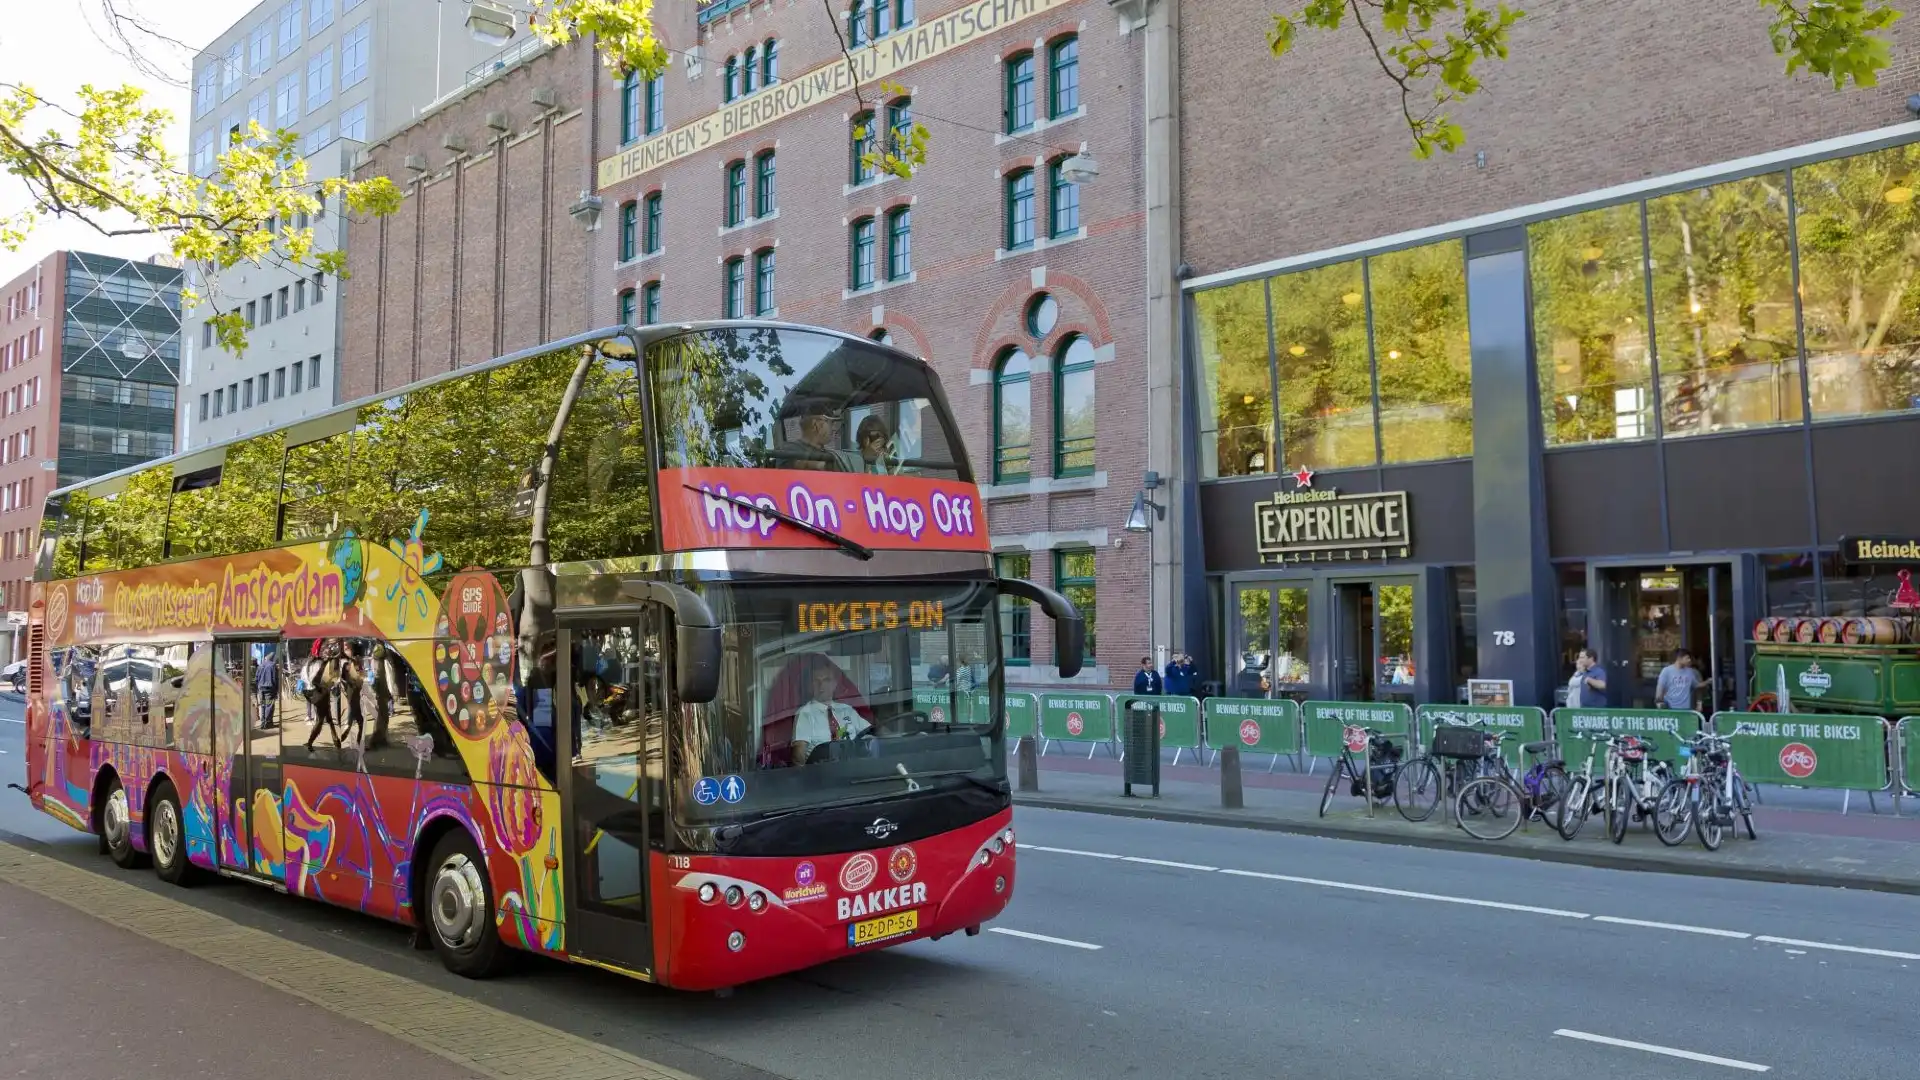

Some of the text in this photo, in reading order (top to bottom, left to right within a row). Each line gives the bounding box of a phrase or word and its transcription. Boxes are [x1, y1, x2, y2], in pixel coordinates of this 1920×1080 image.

[621, 119, 712, 179] HEINEKEN'S
[892, 0, 1050, 68] MAATSCHA
[1274, 488, 1336, 504] Heineken
[699, 483, 779, 538] Hop
[788, 484, 841, 530] On
[863, 489, 926, 539] Hop
[931, 491, 976, 535] Off
[1262, 501, 1400, 543] EXPERIENCE
[219, 562, 343, 629] Amsterdam
[462, 587, 483, 602] GPS
[462, 602, 482, 613] GUIDE
[908, 600, 943, 628] ON
[1493, 631, 1516, 646] 78
[1216, 704, 1284, 717] BEWARE OF THE BIKES!
[1345, 708, 1354, 720] OF
[1356, 708, 1370, 720] THE
[1371, 709, 1395, 722] BIKES!
[1496, 713, 1524, 726] BIKES!
[1572, 715, 1679, 731] BEWARE OF THE BIKES!
[1782, 723, 1797, 737] OF
[1800, 724, 1820, 738] THE
[1823, 725, 1861, 740] BIKES!
[674, 856, 691, 869] 118
[837, 881, 928, 920] BAKKER
[858, 913, 914, 939] BZ-DP-56
